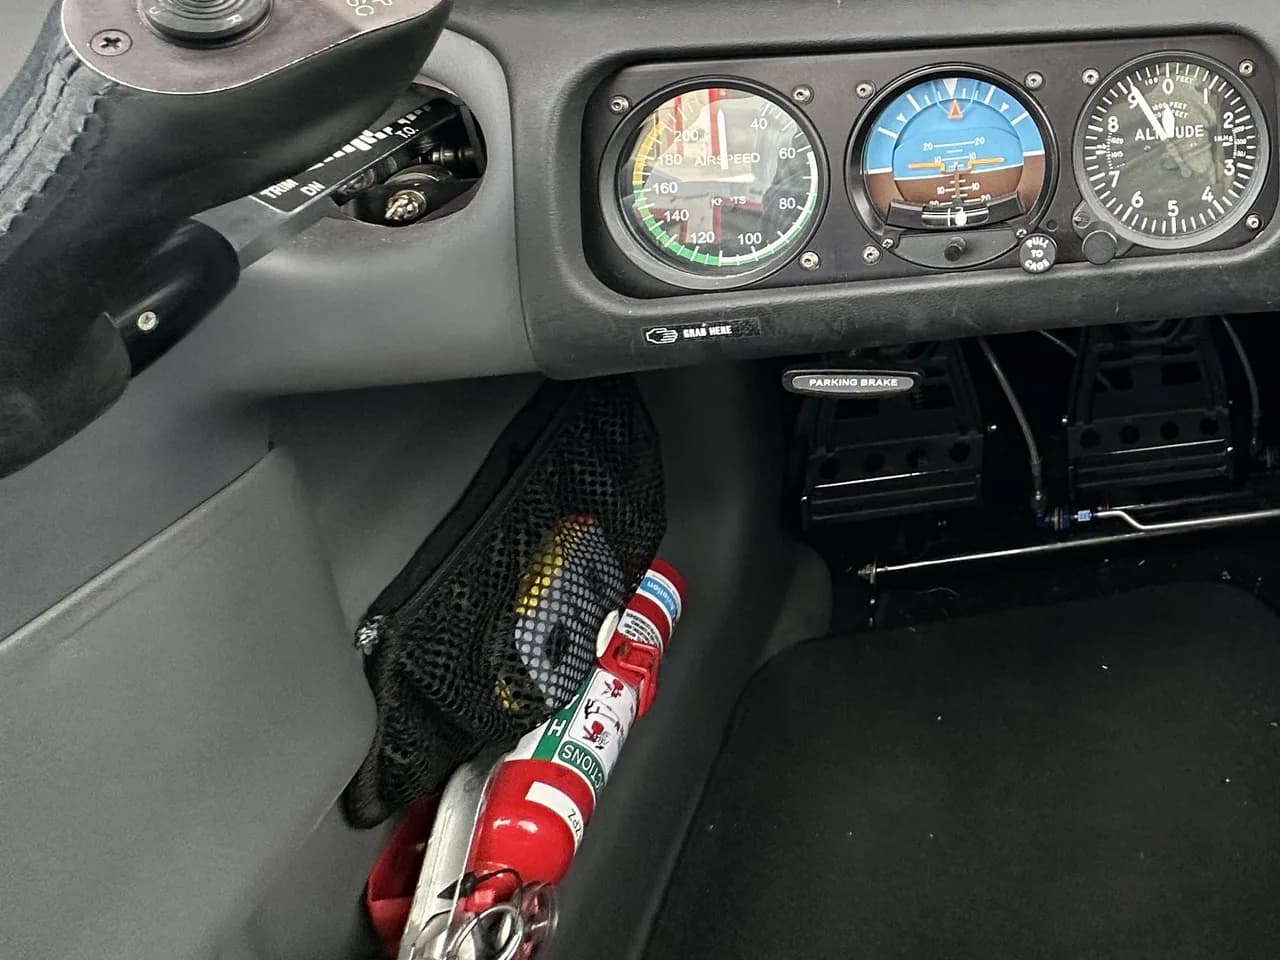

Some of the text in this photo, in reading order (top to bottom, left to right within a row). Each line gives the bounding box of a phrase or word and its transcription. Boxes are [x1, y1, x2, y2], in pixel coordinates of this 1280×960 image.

[779, 149, 795, 159] 60
[695, 154, 759, 166] AIRSPEED
[260, 178, 299, 199] TRIM
[301, 180, 326, 197] DN
[653, 183, 678, 193] 160
[779, 198, 795, 209] 80
[664, 210, 689, 221] 140
[691, 233, 714, 243] 120
[739, 233, 761, 244] 100
[1026, 238, 1049, 250] PULL
[1031, 250, 1043, 258] TO
[1025, 258, 1050, 271] CAGE
[683, 325, 732, 338] GRAB HERE
[809, 378, 898, 387] PARKING BRAKE
